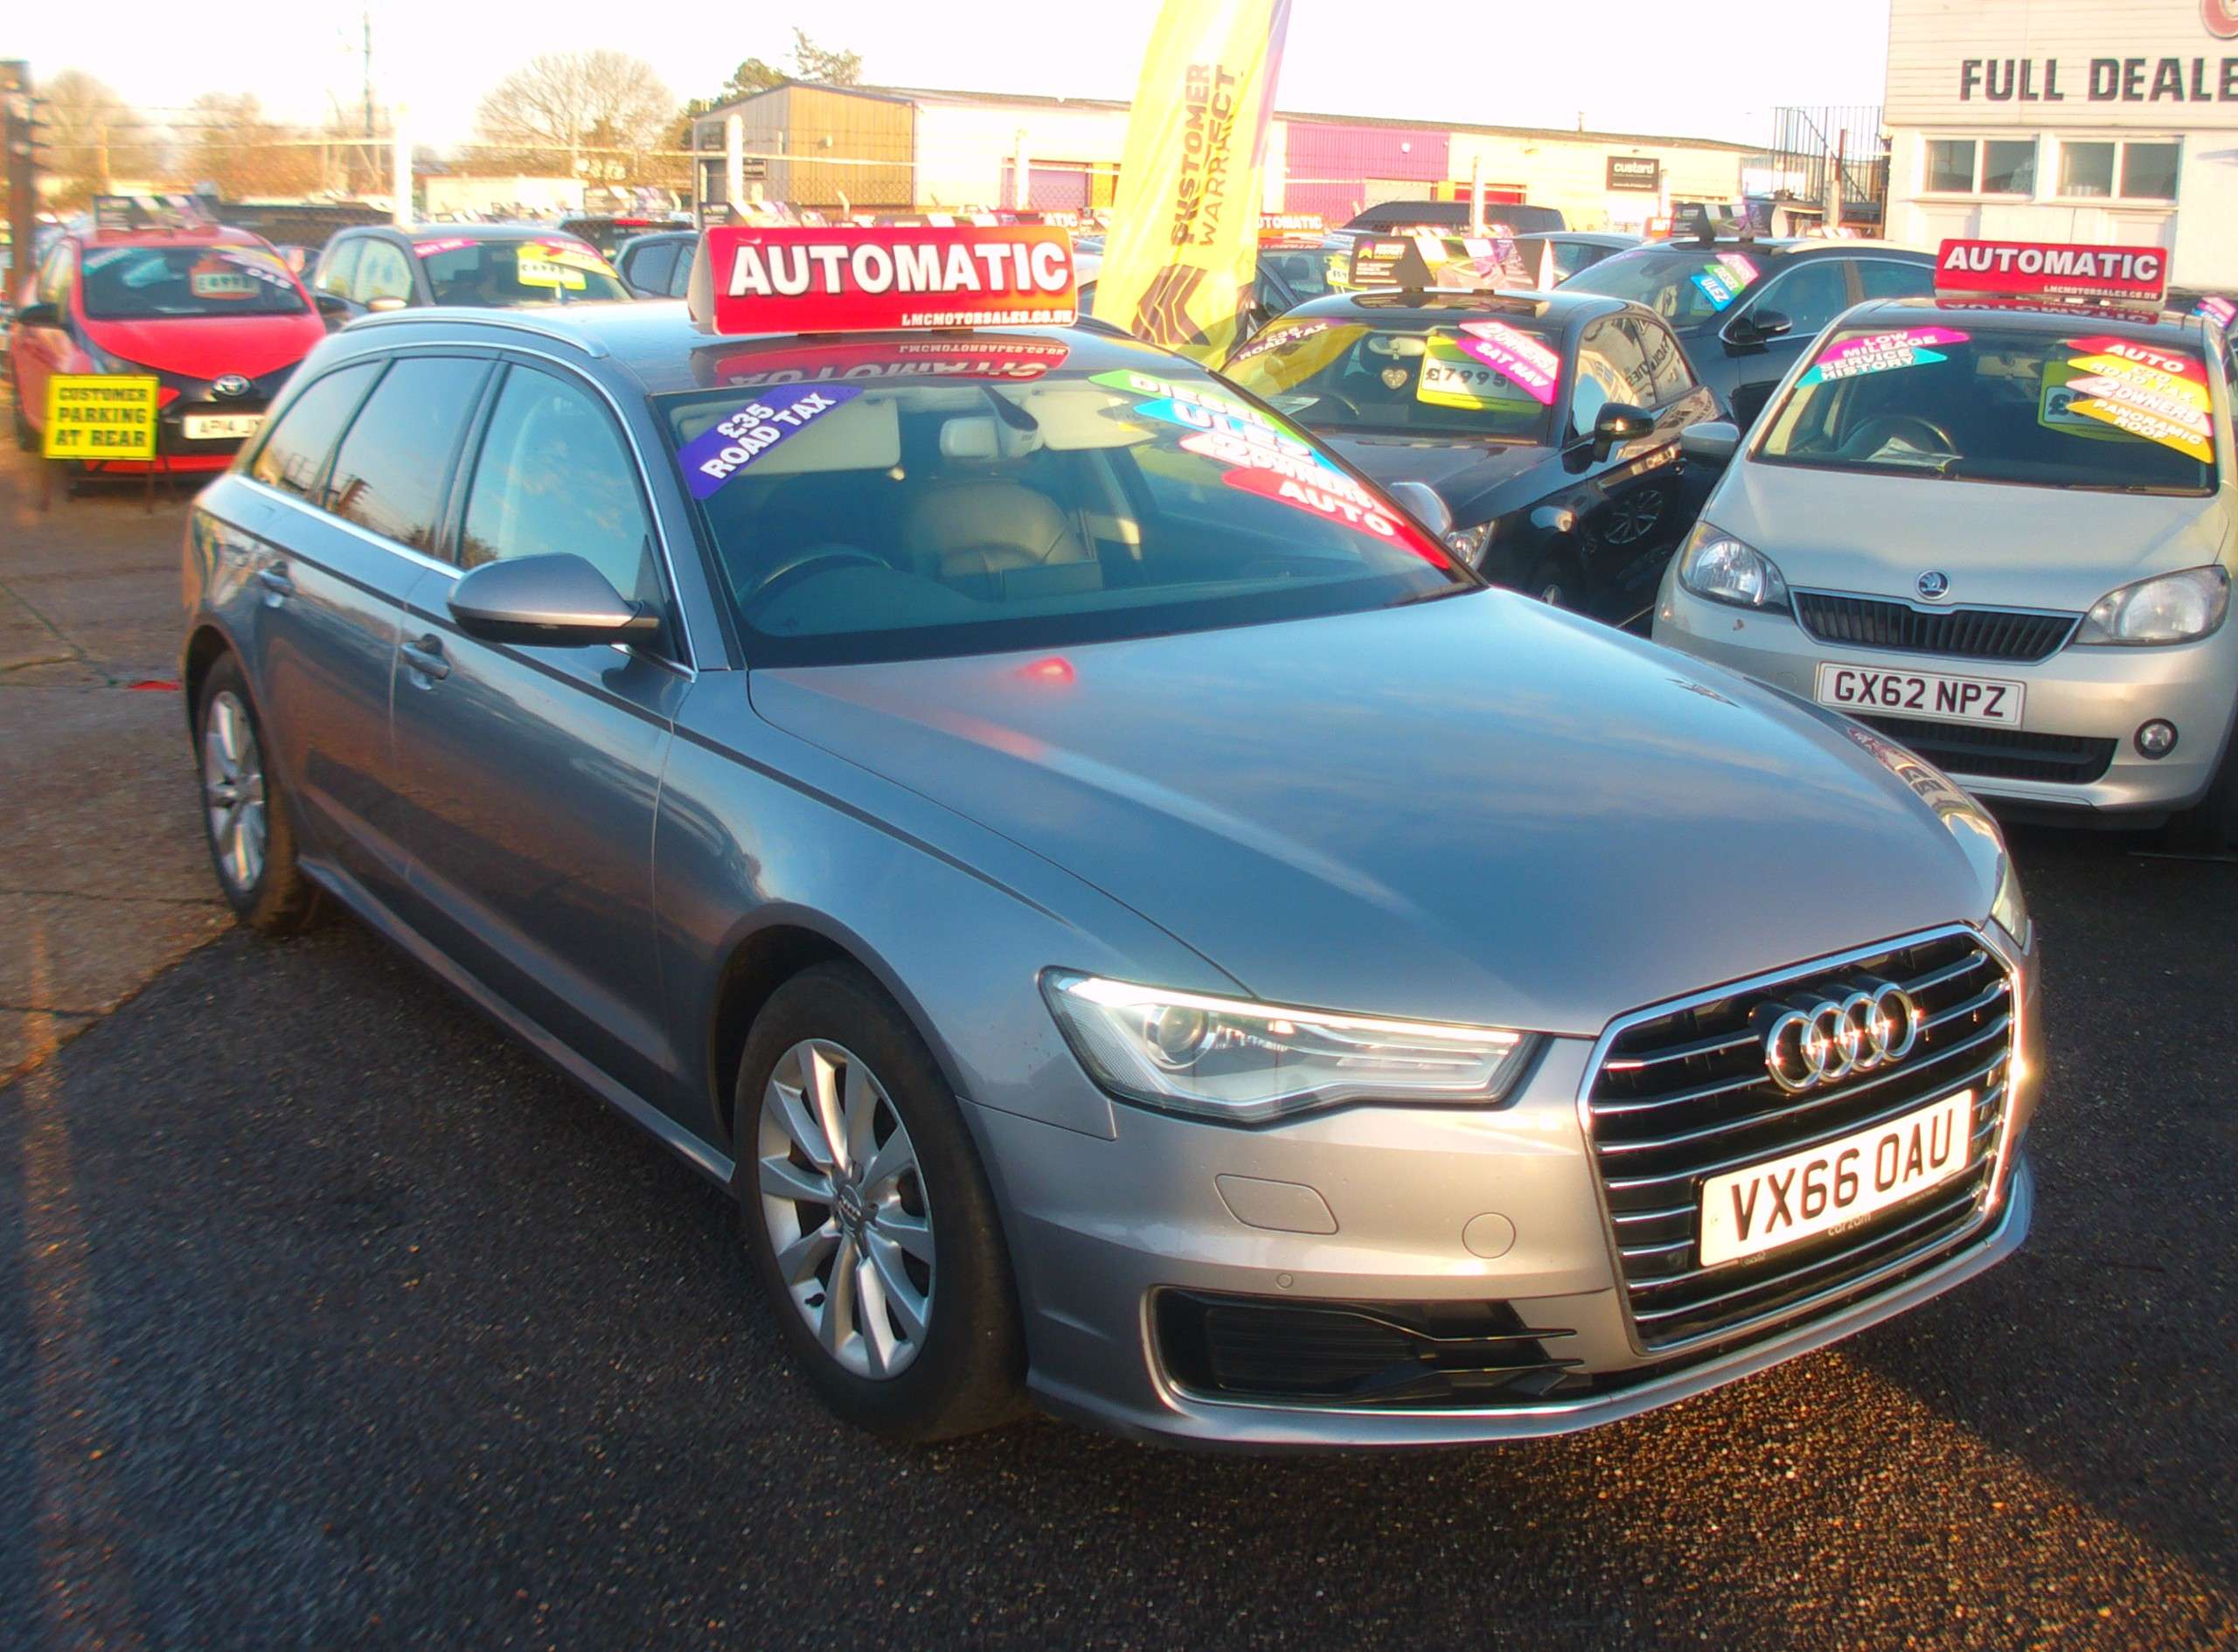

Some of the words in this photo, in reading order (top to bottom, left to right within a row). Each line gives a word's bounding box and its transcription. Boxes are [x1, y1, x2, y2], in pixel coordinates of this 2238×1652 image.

[1959, 59, 2064, 101] FULL
[1613, 162, 1654, 174] custard
[729, 241, 1068, 296] AUTOMATIC
[1943, 246, 2158, 281] AUTOMATIC
[1699, 277, 1730, 302] ULEZ
[2043, 285, 2158, 301] LMCMOTORSALES.CO.UK
[901, 310, 1074, 326] LMCMOTORSALES.CO.UK
[1240, 337, 1288, 360] ROAD
[1292, 323, 1328, 339] TAX
[1842, 336, 1938, 358] MILEAGE
[1863, 332, 1908, 346] LOW
[1476, 342, 1515, 364] SAT
[1509, 362, 1549, 387] NAV
[1819, 348, 1913, 371] SERVICE
[1821, 357, 1915, 381] HISTORY
[2104, 344, 2185, 373] AUTO
[59, 388, 148, 402] CUSTOMER
[1426, 367, 1507, 388] £7995
[2089, 362, 2148, 385] ROAD
[2156, 380, 2197, 404] TAX
[58, 407, 147, 423] PARKING
[1128, 373, 1276, 432] DIESEL
[2088, 376, 2122, 399] 2
[2115, 386, 2200, 425] OWNERS
[55, 429, 81, 446] AT
[91, 430, 147, 447] REAR
[699, 425, 781, 479] ROAD
[771, 392, 837, 427] TAX
[716, 403, 775, 439] £35
[1171, 401, 1313, 457] ULEZ
[2092, 399, 2203, 445] PANORAMIC
[2113, 417, 2169, 441] ROOF
[1278, 480, 1394, 536] AUTO
[1834, 671, 1926, 709] GX62
[1936, 680, 2006, 718] NPZ
[1731, 1147, 1860, 1242] VX66
[1873, 1107, 1953, 1193] OAU
